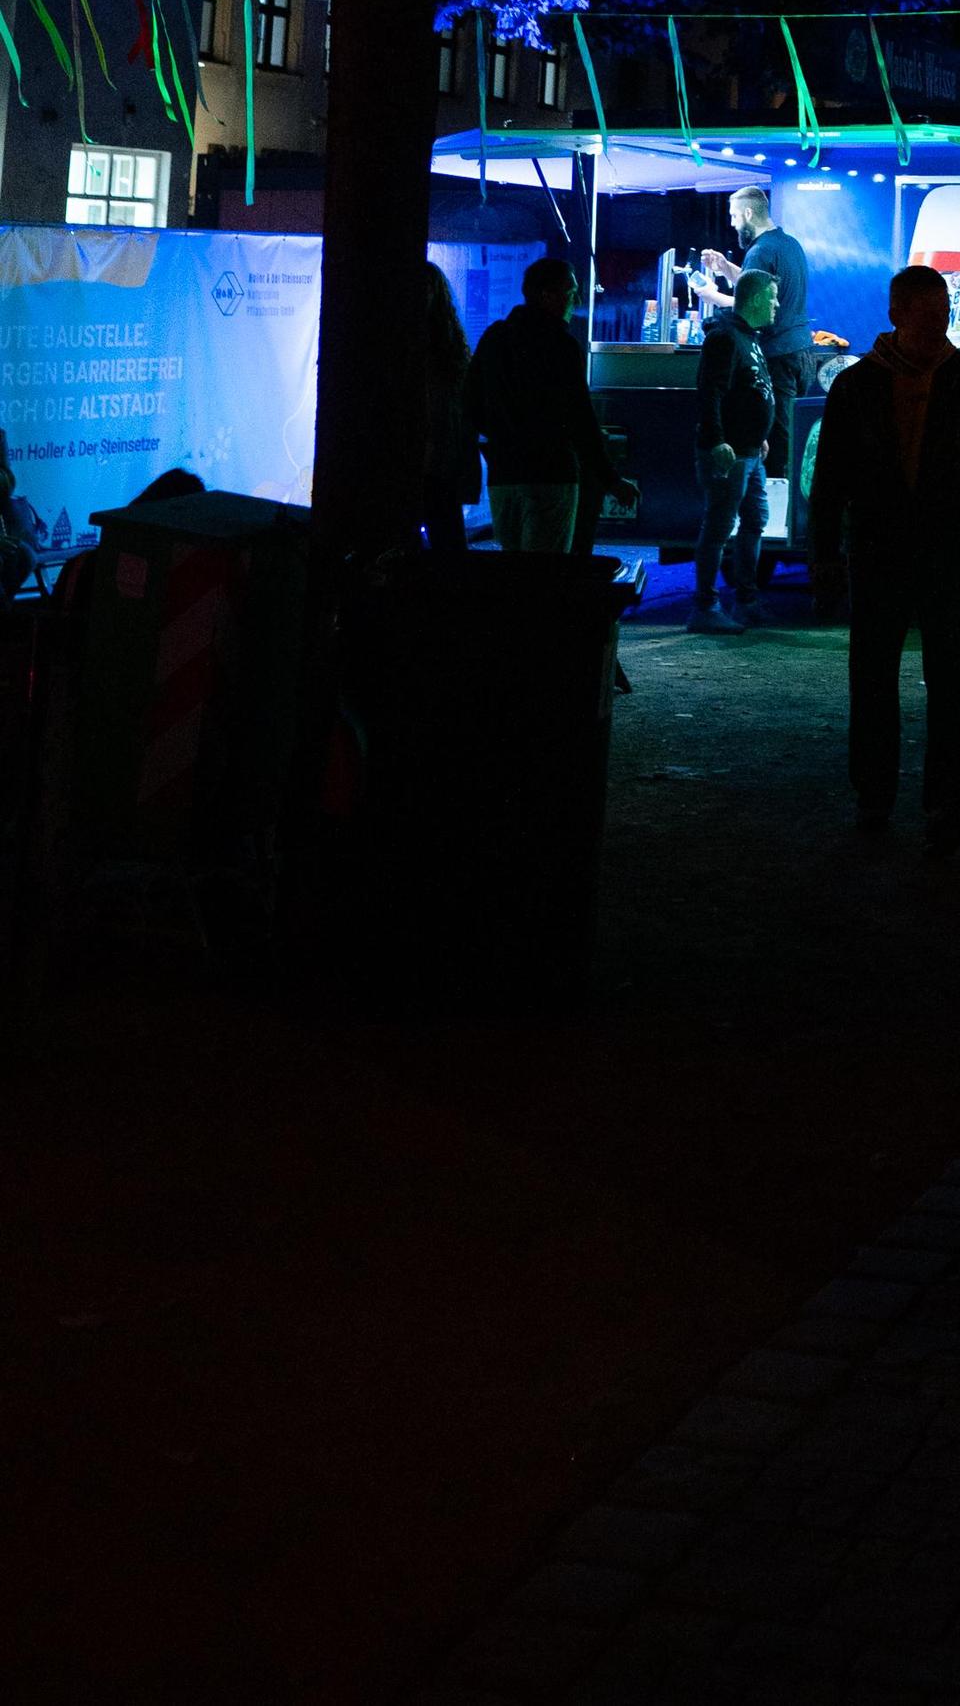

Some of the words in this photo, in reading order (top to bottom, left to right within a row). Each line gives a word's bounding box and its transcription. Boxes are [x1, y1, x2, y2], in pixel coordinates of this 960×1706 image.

[44, 323, 148, 347] BAUSTELLE.
[63, 357, 183, 384] BARRIEREFREI
[44, 396, 75, 421] DIE
[28, 442, 65, 461] Holler
[67, 441, 75, 458] &
[79, 440, 97, 456] Der
[100, 437, 160, 455] Steinsetzer
